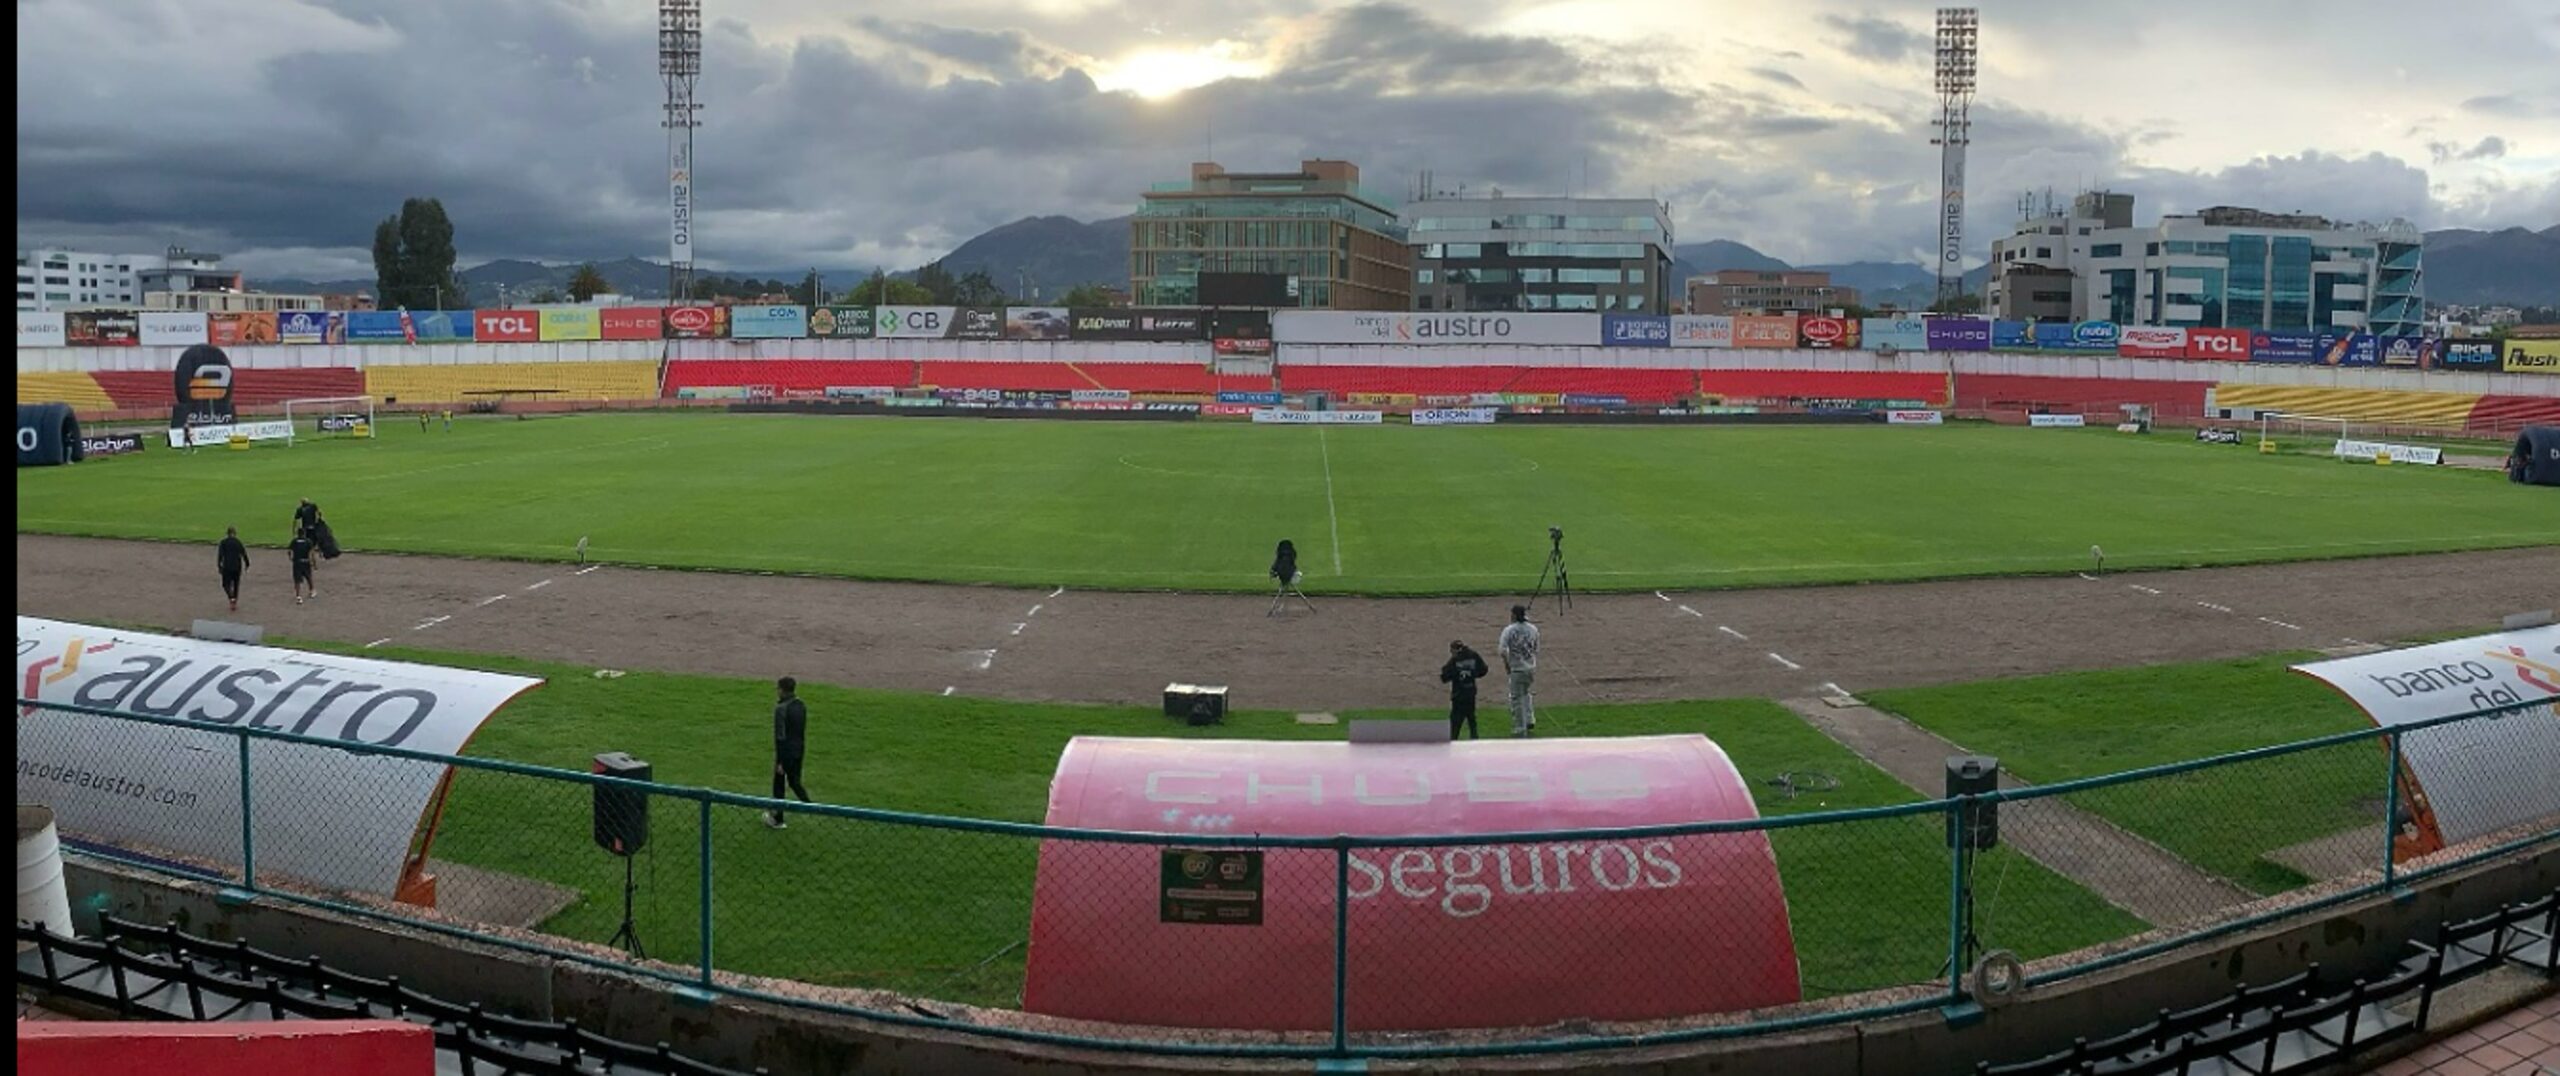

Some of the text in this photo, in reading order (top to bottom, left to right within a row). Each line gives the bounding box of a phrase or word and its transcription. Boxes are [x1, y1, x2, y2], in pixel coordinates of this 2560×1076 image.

[673, 185, 688, 245] austro
[1946, 203, 1962, 262] austro
[482, 318, 532, 334] TCL
[906, 311, 940, 330] CB
[1416, 315, 1510, 337] austro
[1628, 329, 1645, 339] DEL
[2193, 335, 2244, 352] TCL
[2447, 352, 2497, 363] SHOP
[2450, 344, 2492, 353] BIKE
[1425, 410, 1469, 419] ORION
[2369, 659, 2494, 698] banco
[74, 654, 437, 756] austro
[2469, 682, 2522, 720] del
[1345, 839, 1682, 918] Seguros
